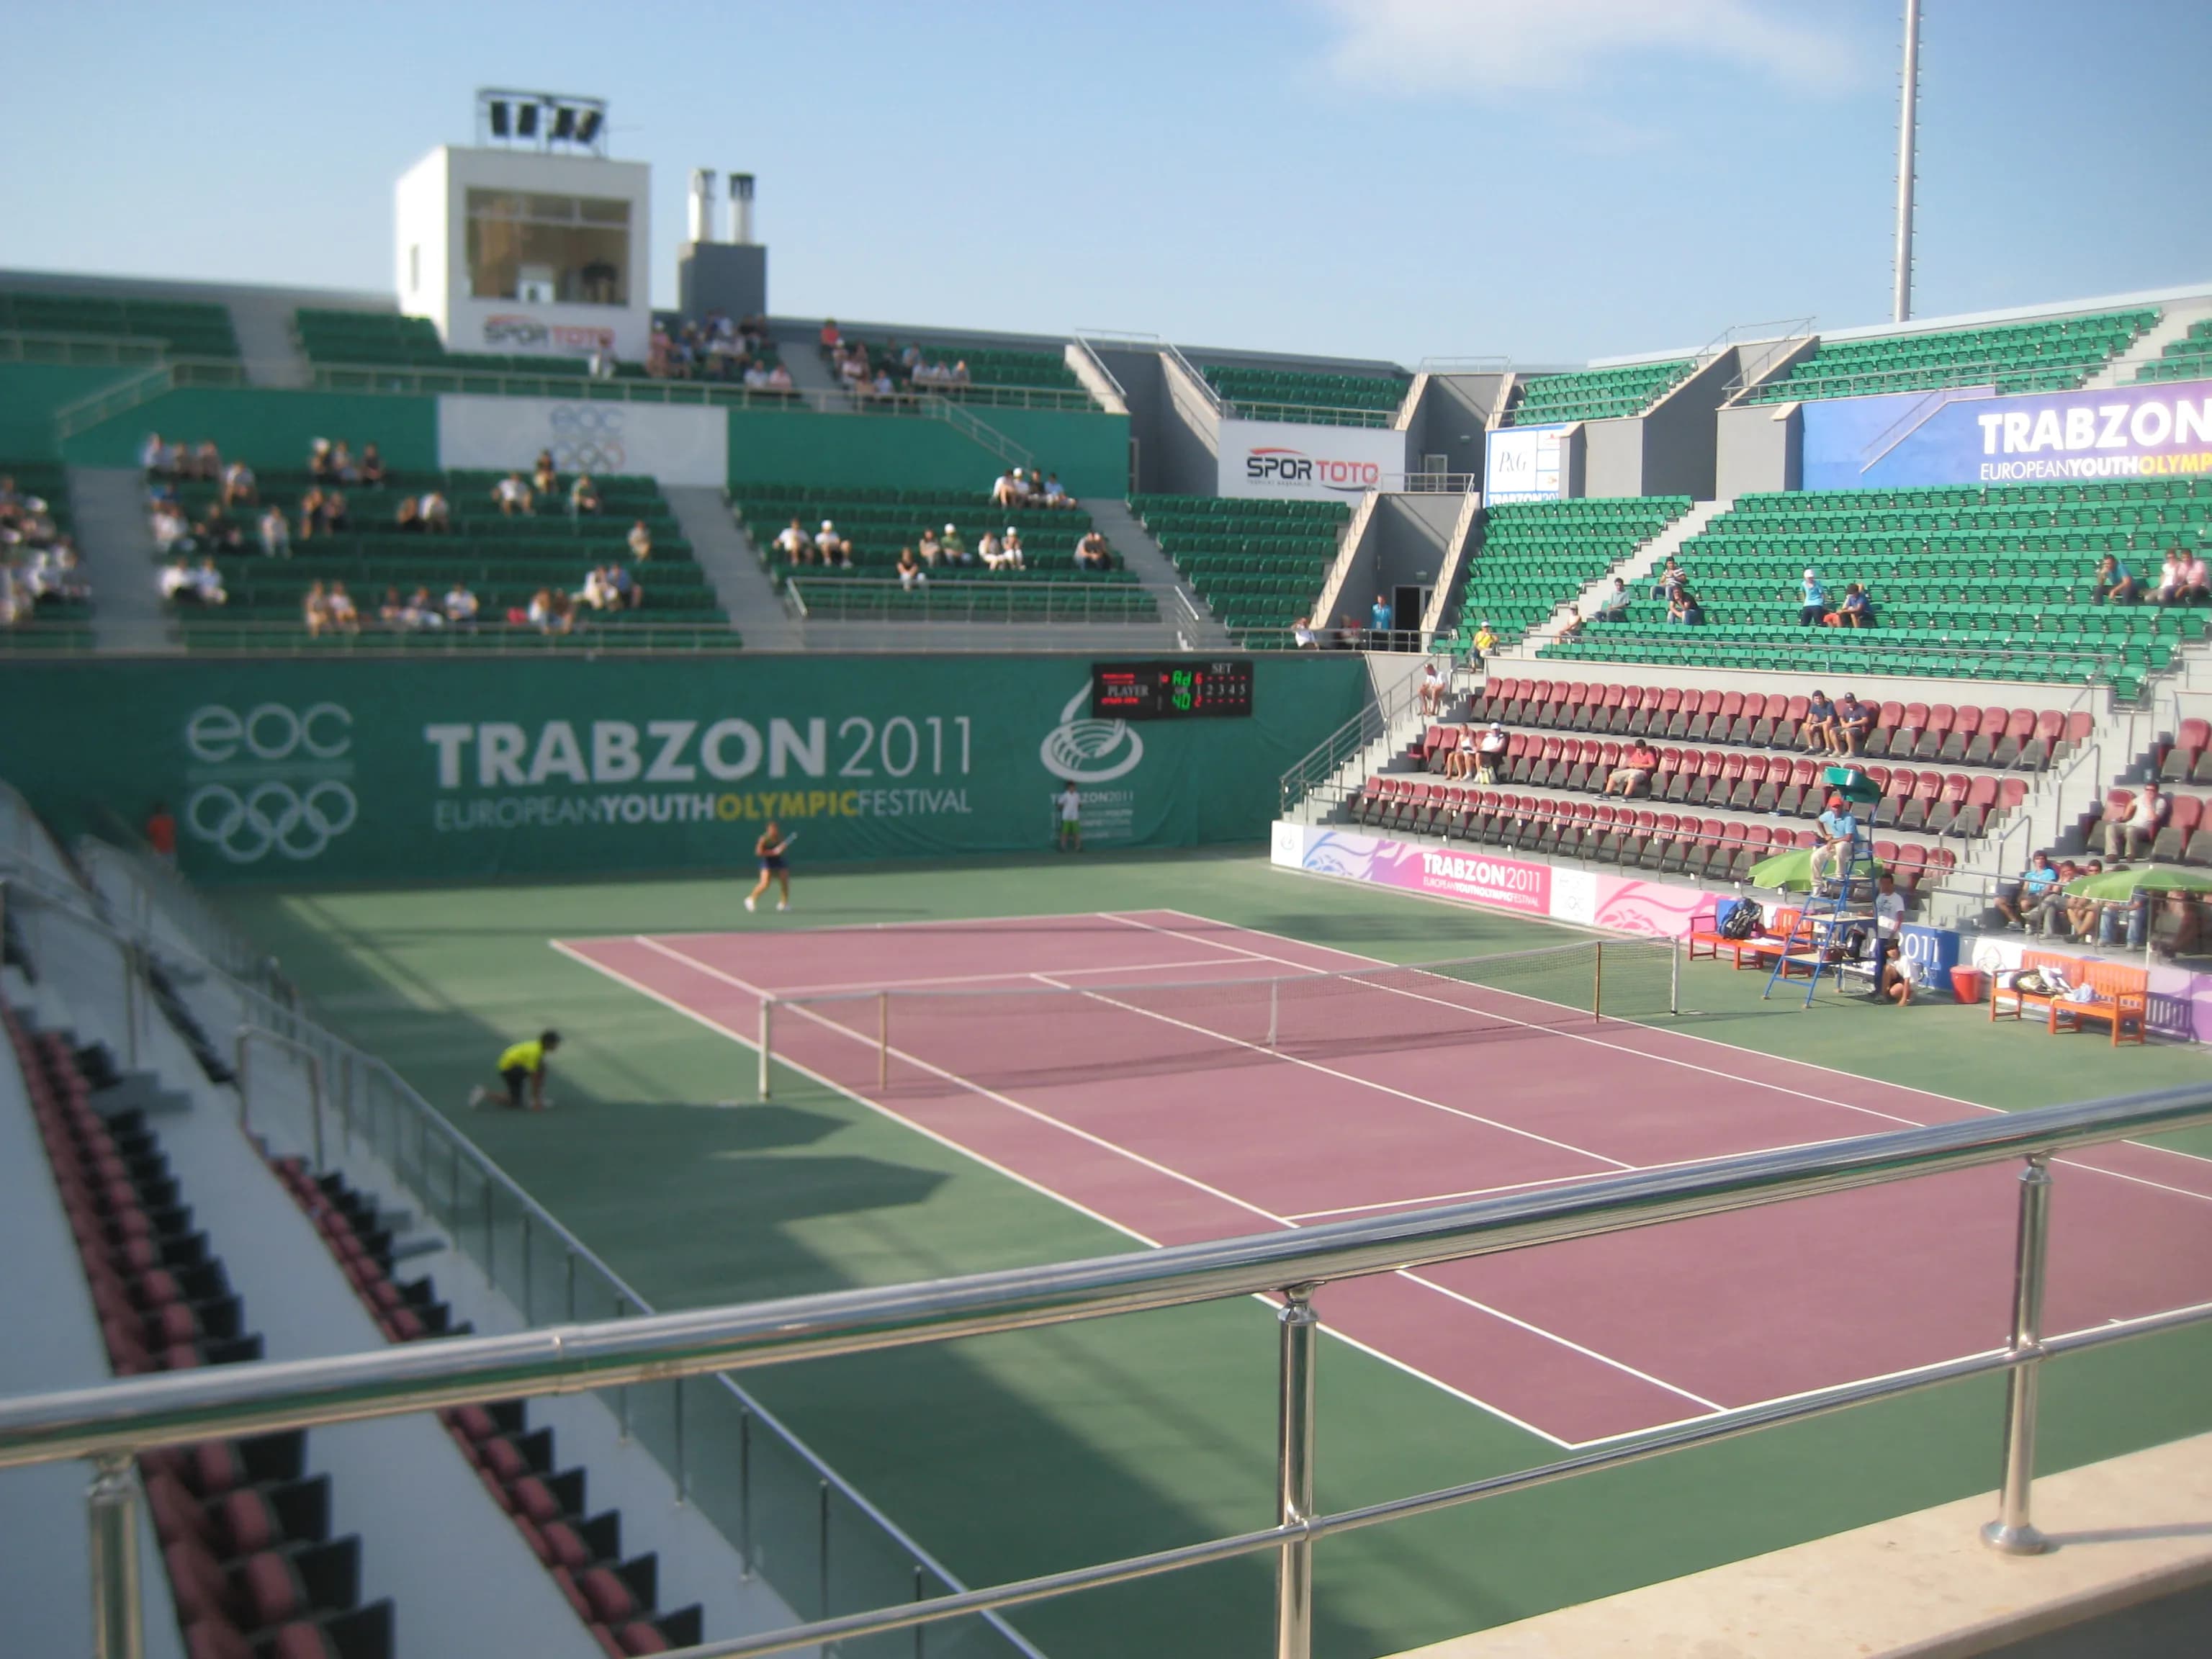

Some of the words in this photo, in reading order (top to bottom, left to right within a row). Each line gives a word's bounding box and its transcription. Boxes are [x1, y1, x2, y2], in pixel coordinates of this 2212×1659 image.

[1978, 397, 2212, 455] TRABZON
[1246, 457, 1312, 480] SPOR
[1316, 460, 1379, 485] TOTO
[1211, 662, 1233, 674] SET
[1107, 685, 1149, 697] PLAYER
